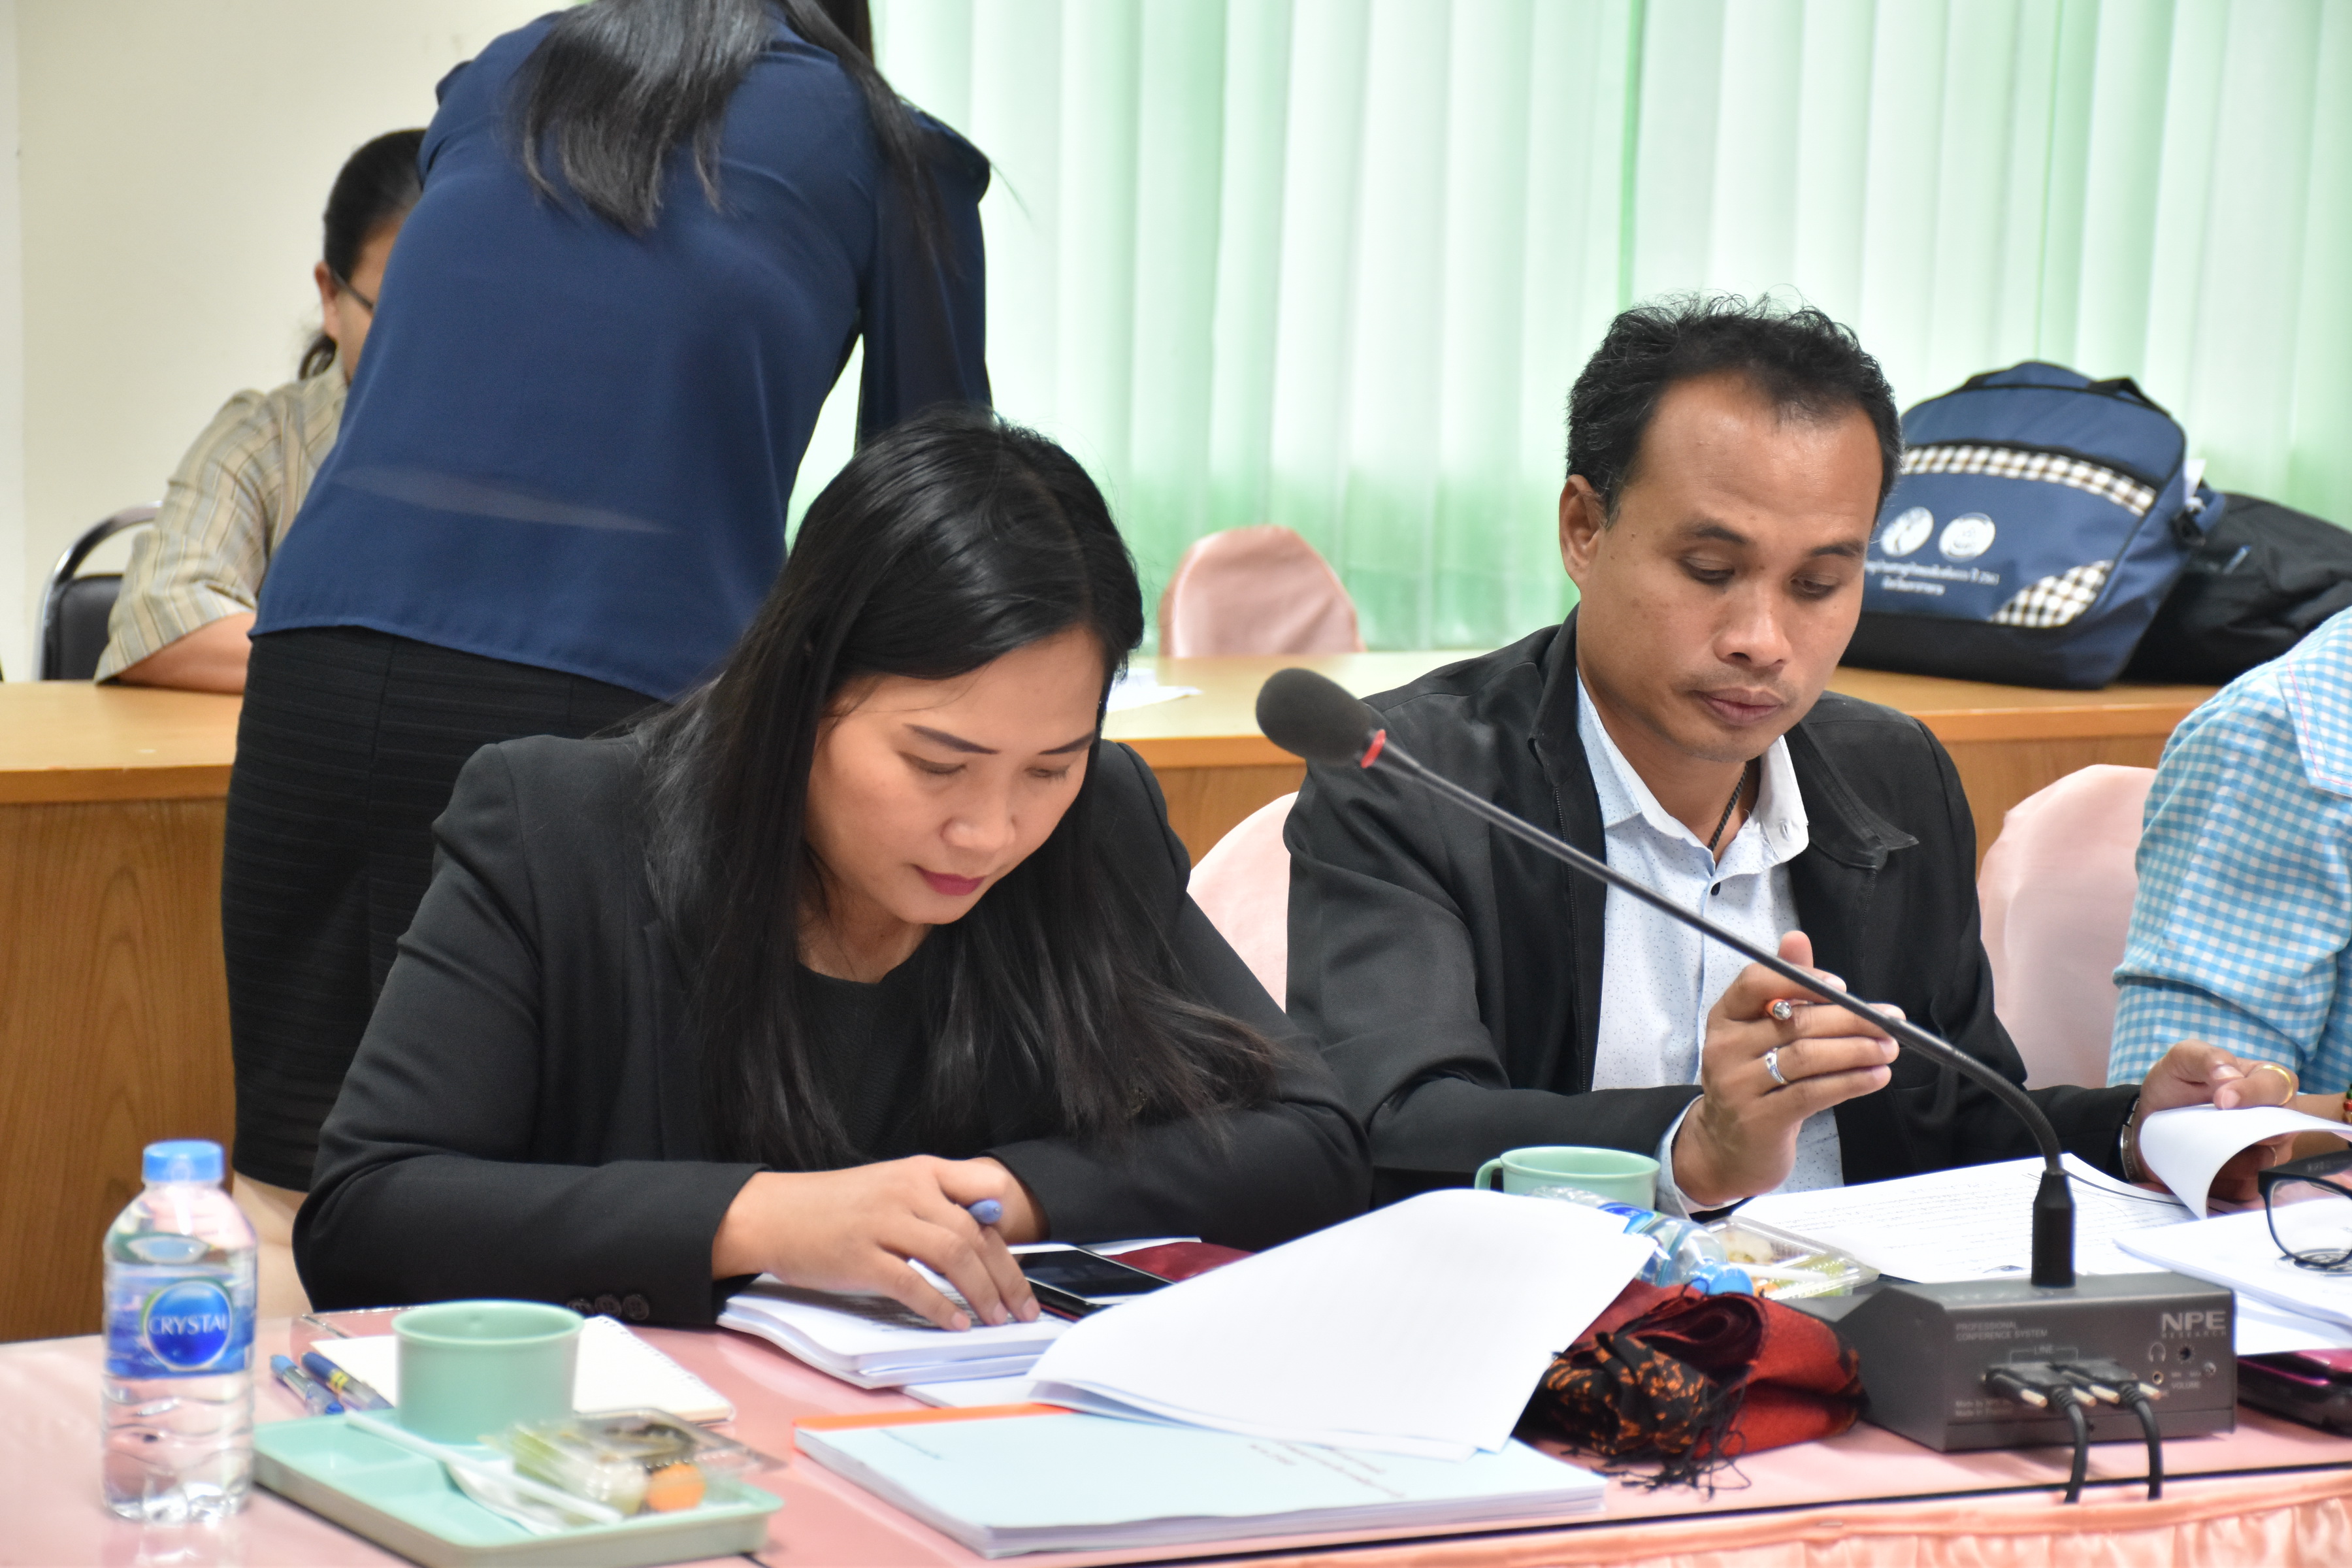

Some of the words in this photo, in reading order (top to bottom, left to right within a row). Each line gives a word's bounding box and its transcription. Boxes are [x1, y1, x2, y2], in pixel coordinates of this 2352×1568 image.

[1955, 1321, 2017, 1331] PROFESSIONAL
[2161, 1310, 2227, 1331] NPE
[1955, 1330, 2012, 1341] CONFERENCE
[2014, 1328, 2049, 1339] SYSTEM
[2161, 1330, 2227, 1339] RESEARCH
[2034, 1343, 2053, 1355] LINE
[2171, 1380, 2201, 1390] VOLUME
